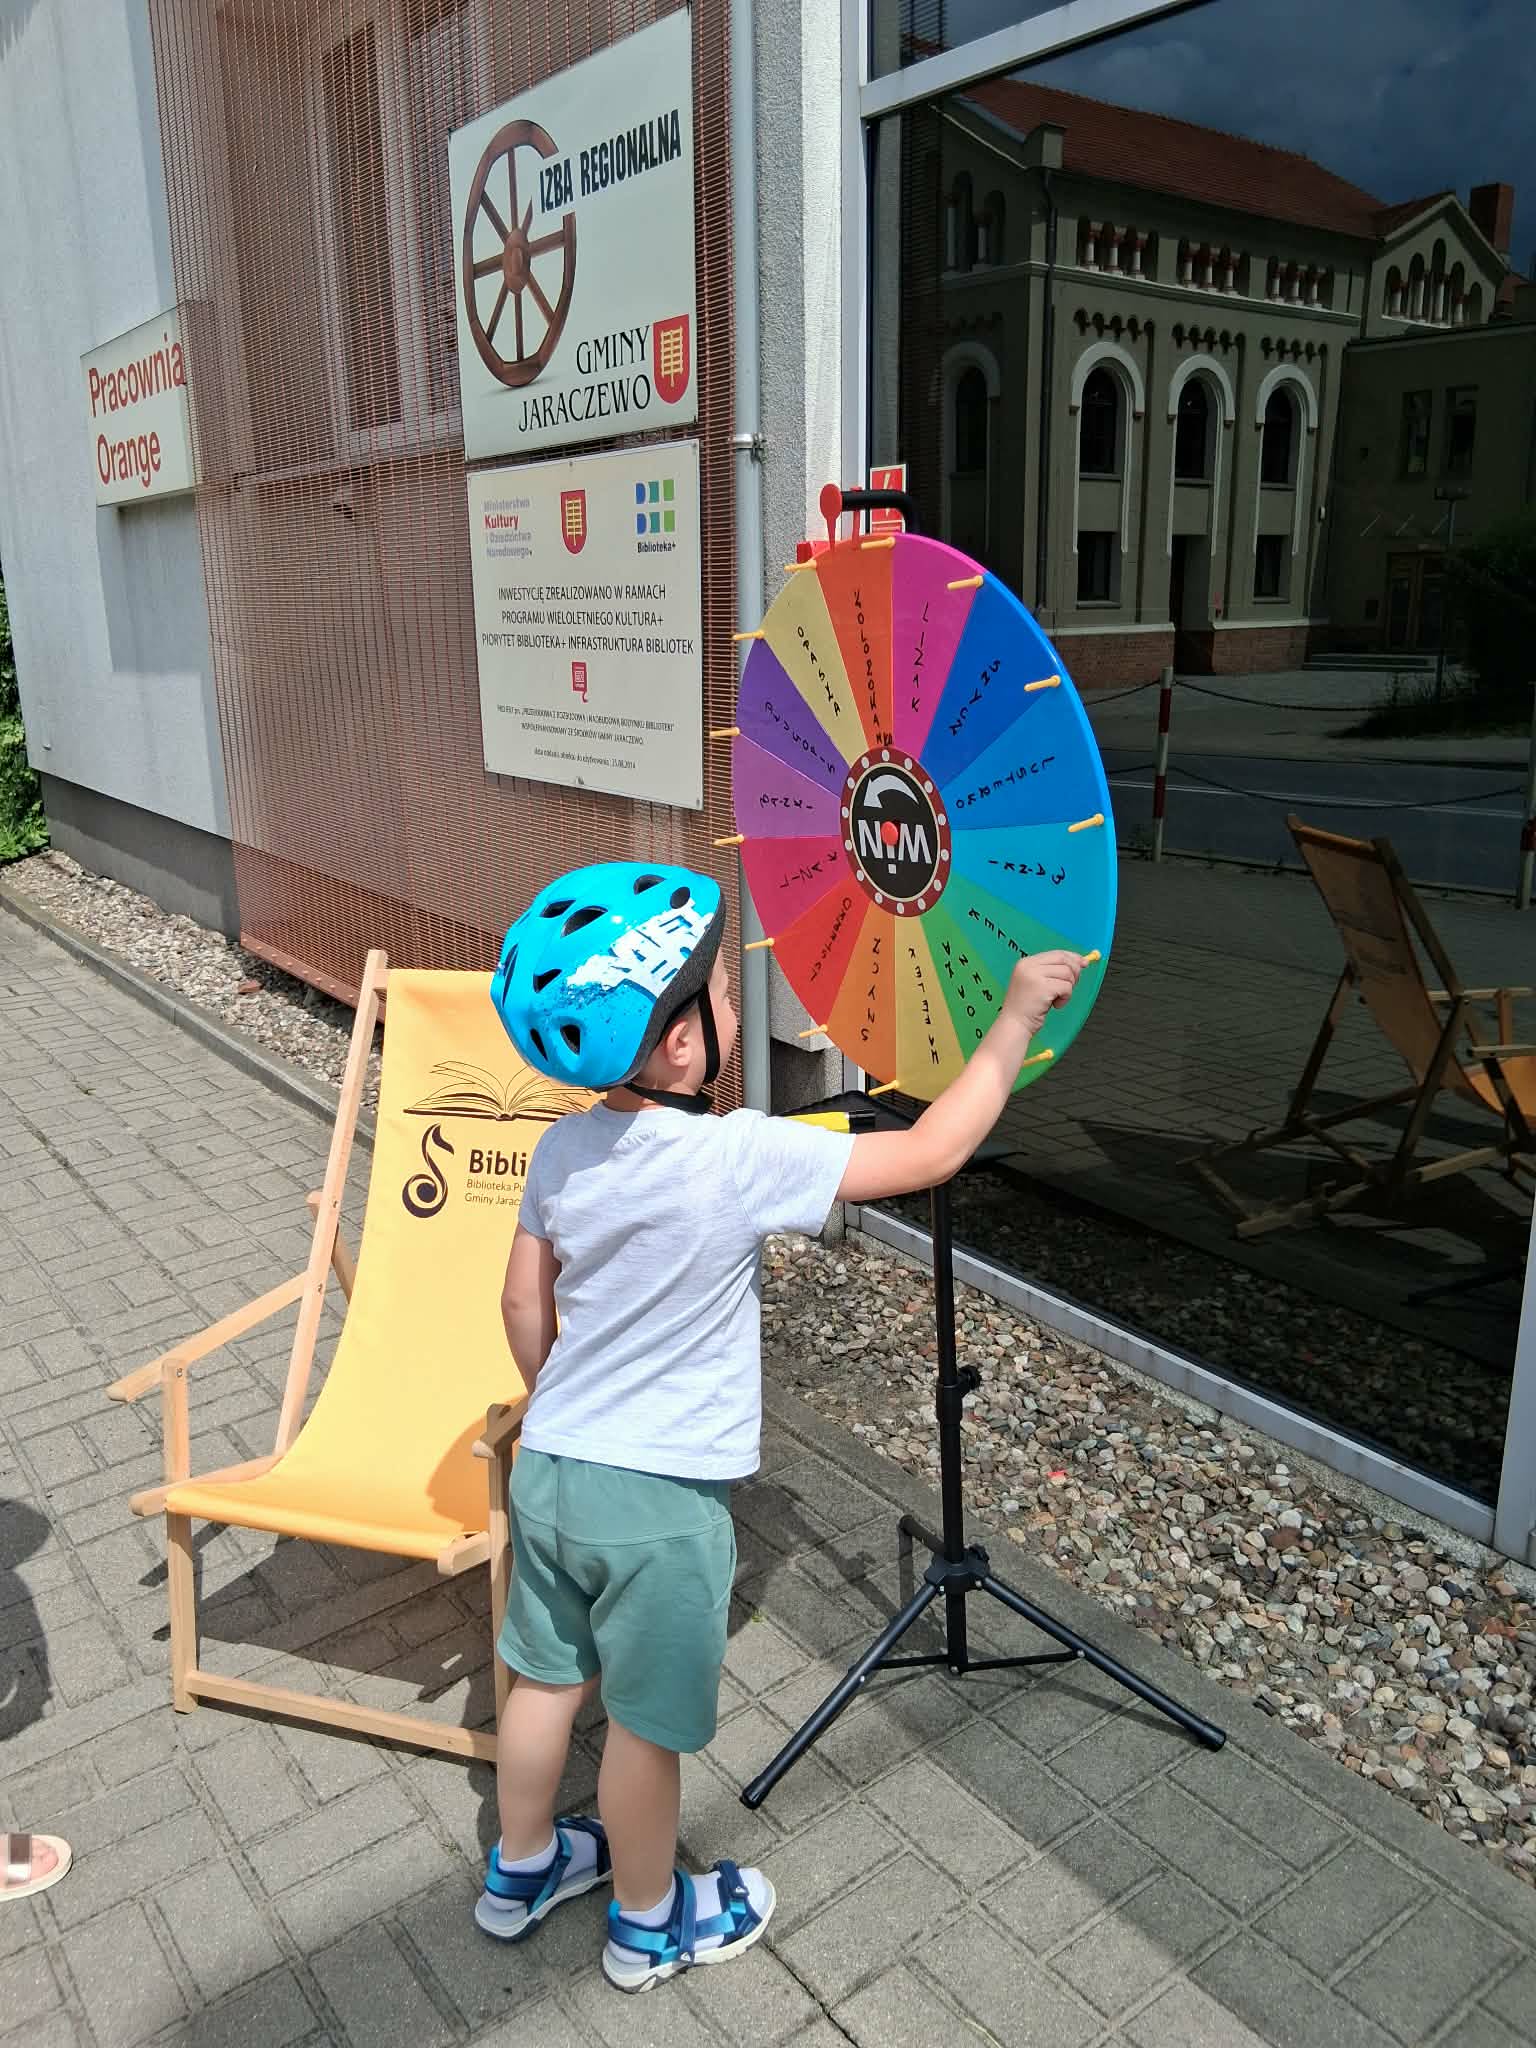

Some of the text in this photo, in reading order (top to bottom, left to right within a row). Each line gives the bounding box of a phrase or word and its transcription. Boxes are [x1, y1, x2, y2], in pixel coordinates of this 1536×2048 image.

[539, 109, 682, 213] IZBA REGIONALNA
[88, 332, 185, 418] Pracownia
[576, 325, 650, 375] GMINY
[518, 374, 651, 433] JARACZEWO
[97, 431, 161, 488] Orange
[484, 514, 519, 530] Kultury
[637, 542, 676, 553] Biblioteka+
[546, 586, 612, 600] ZREALIZOWANO
[614, 586, 624, 600] W
[625, 584, 666, 600] RAMACH
[502, 611, 664, 627] PROGRAMU WIELOLETNIEGO KULTURA+
[517, 634, 566, 649] BIBLIOTEKA+
[568, 635, 643, 652] INFRASTRUKTURA
[646, 638, 694, 654] BIBLIOTEK
[797, 626, 841, 716] OPASKA
[911, 601, 929, 713] LIZAK
[948, 660, 1001, 736] SMYCZ
[955, 755, 1055, 809] LUSTERKO
[968, 908, 1028, 959] FELEK
[907, 947, 939, 1065] WAFELEK
[466, 1179, 511, 1191] Biblioteka
[469, 1149, 527, 1177] Bibli
[465, 1193, 521, 1206] Gminy Jarac
